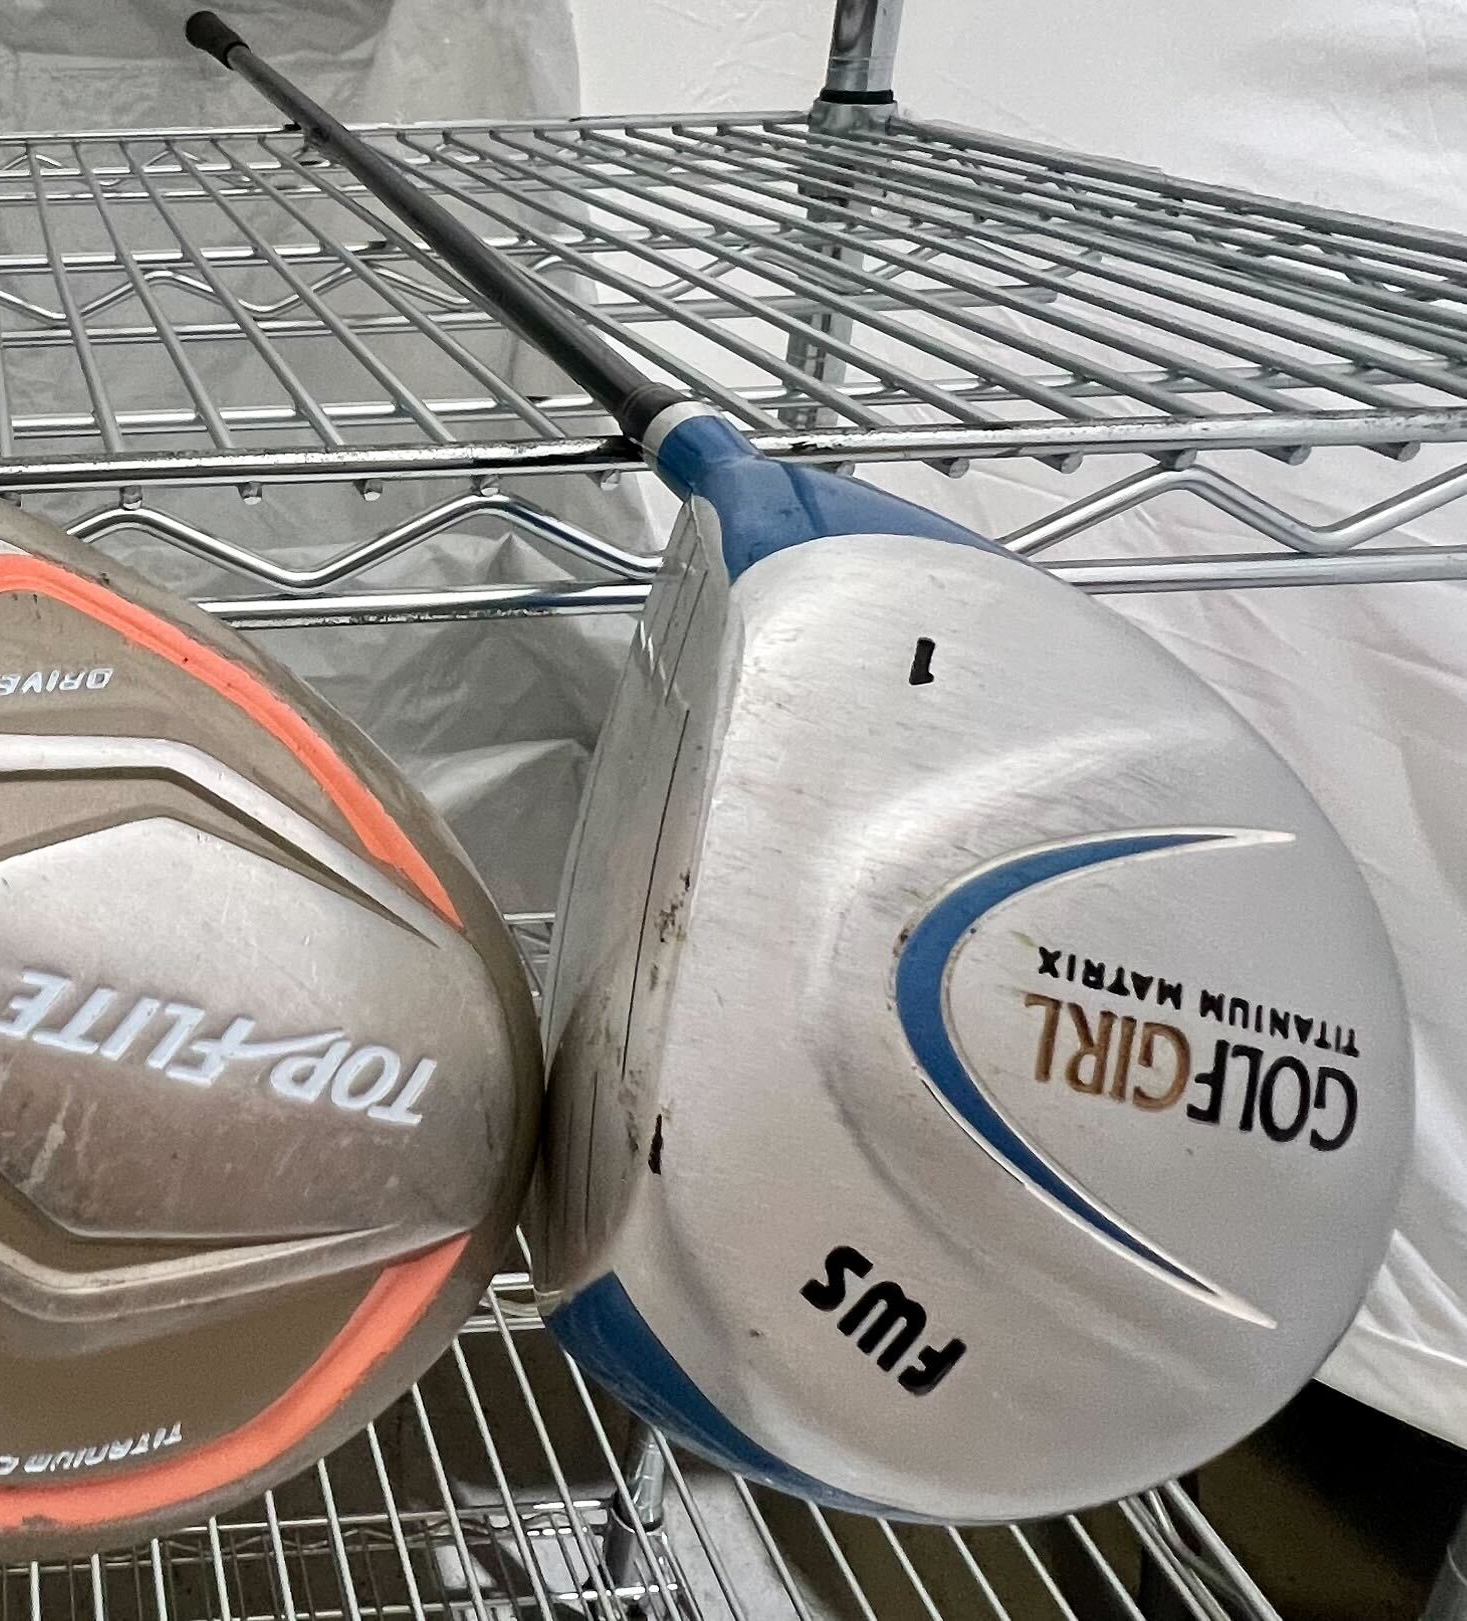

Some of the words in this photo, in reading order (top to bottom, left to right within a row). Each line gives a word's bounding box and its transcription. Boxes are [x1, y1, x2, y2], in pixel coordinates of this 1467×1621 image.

[908, 636, 936, 686] 1
[1037, 945, 1183, 1010] MATRIX
[1199, 989, 1361, 1058] TITANIUM
[269, 1039, 438, 1127] TOP
[798, 1244, 968, 1397] FWS
[23, 1420, 184, 1475] TITANIUM
